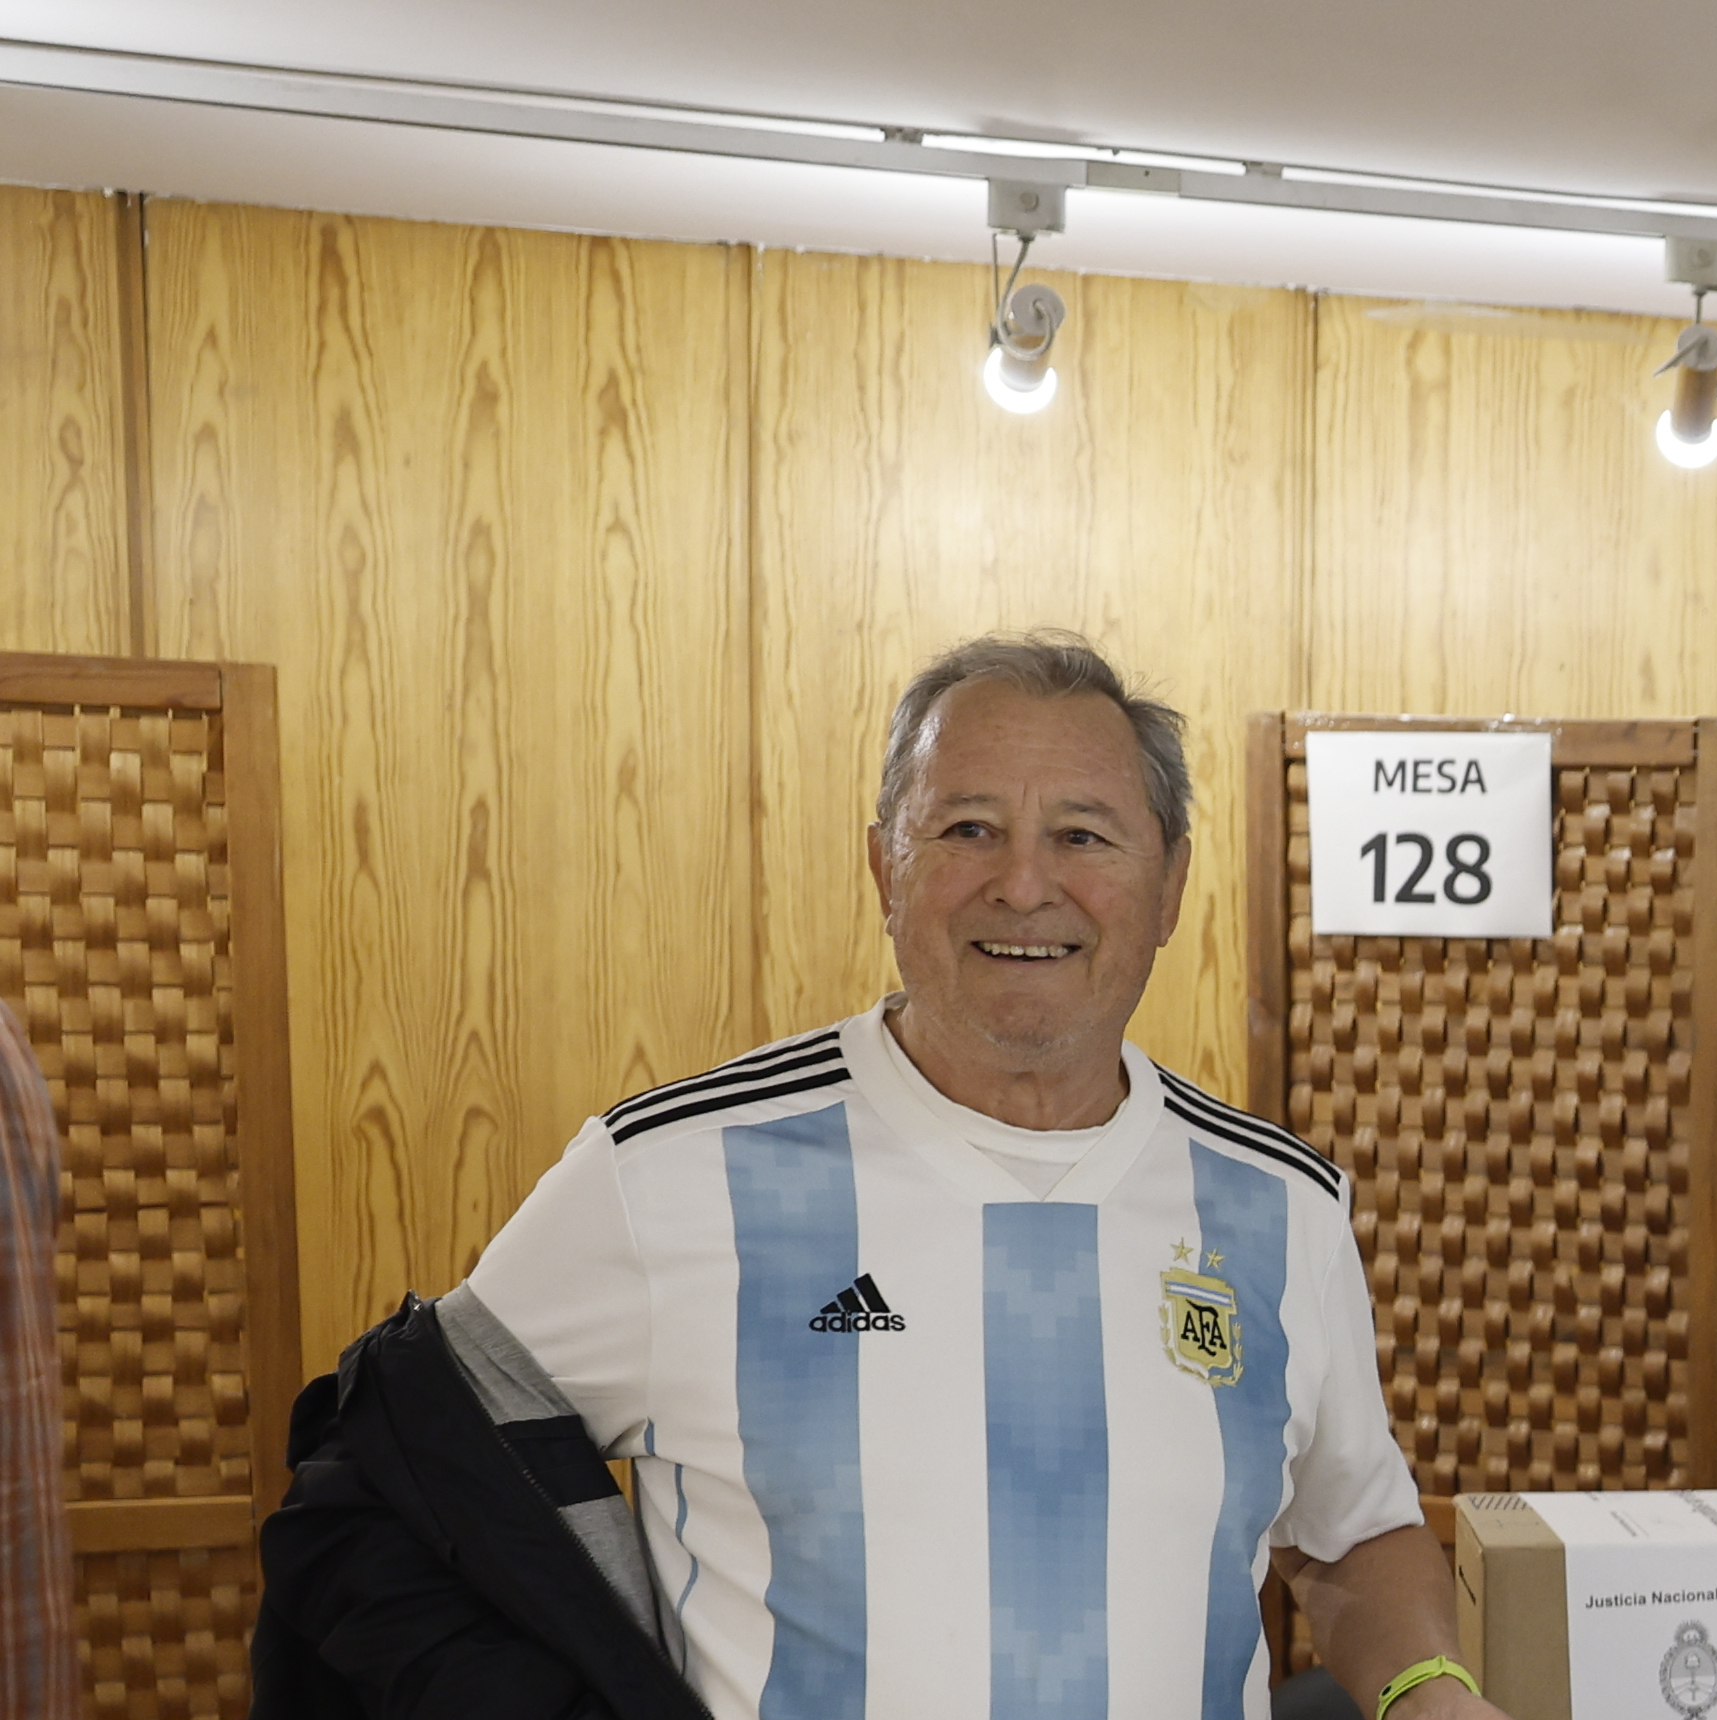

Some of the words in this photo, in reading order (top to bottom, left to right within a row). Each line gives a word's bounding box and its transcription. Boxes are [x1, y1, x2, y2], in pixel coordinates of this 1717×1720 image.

[1373, 759, 1488, 794] MESA
[1359, 831, 1493, 905] 128
[808, 1310, 906, 1334] adidas
[1180, 1299, 1228, 1357] AFA
[1585, 1593, 1647, 1609] Justicia
